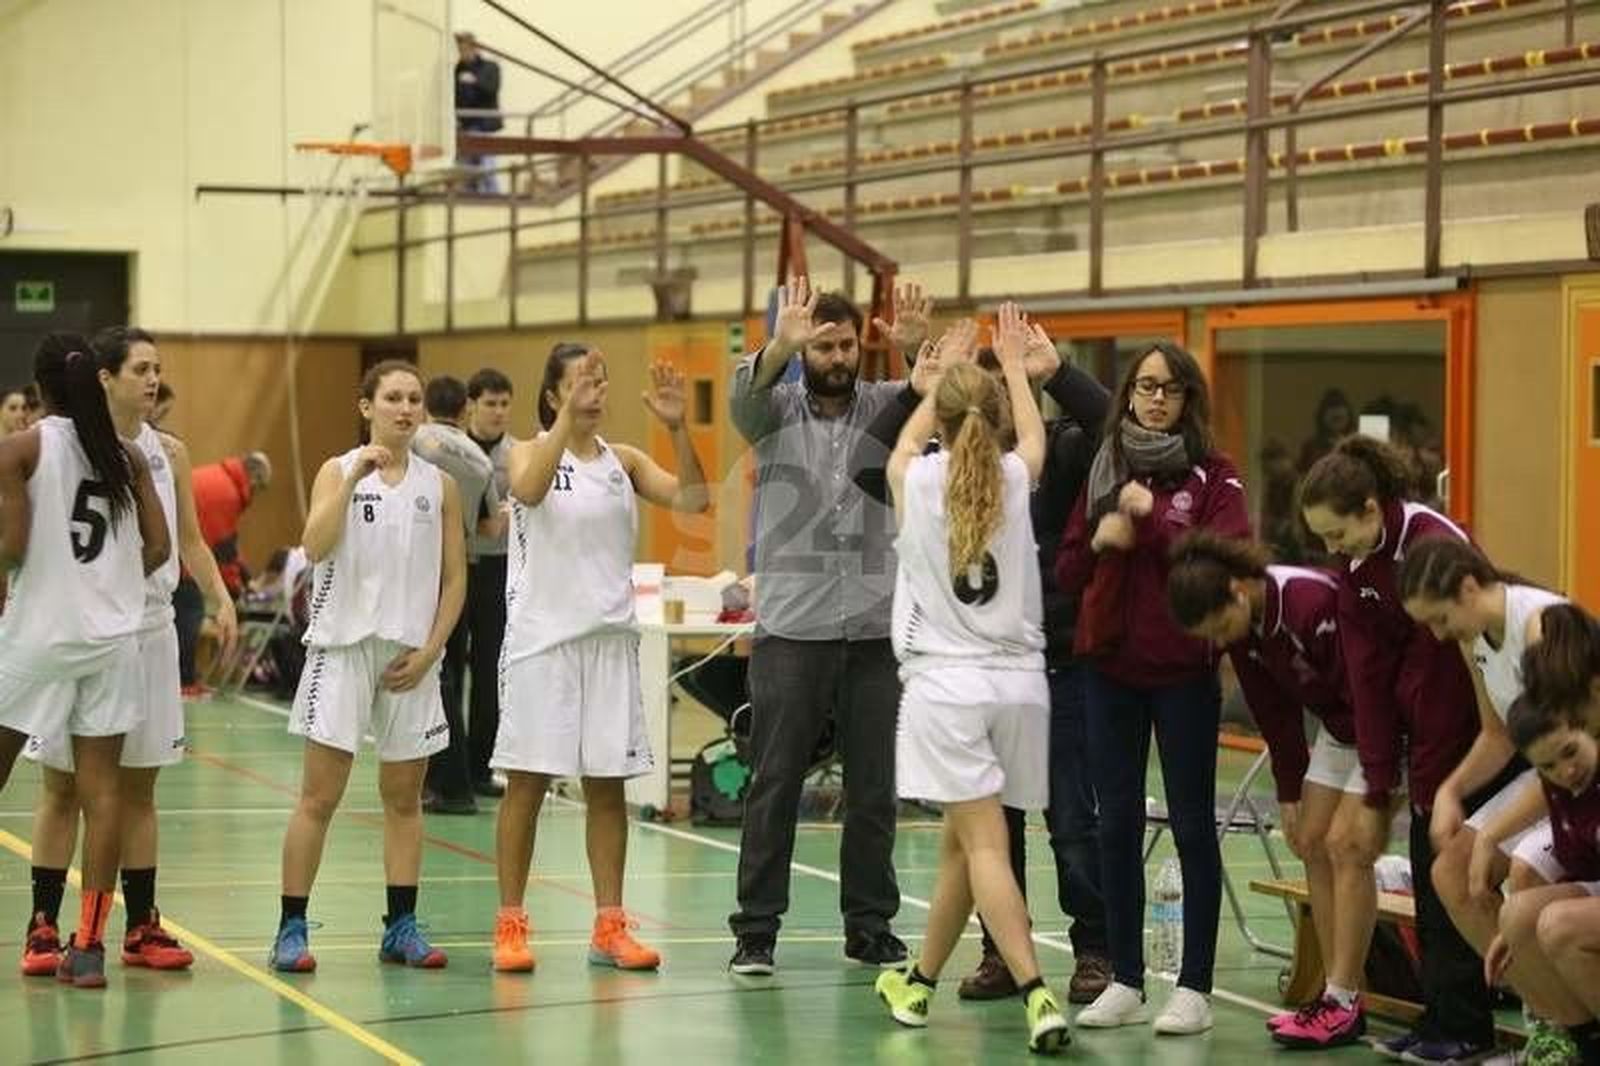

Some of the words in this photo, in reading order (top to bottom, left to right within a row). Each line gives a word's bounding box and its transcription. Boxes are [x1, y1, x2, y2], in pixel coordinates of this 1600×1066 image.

[553, 473, 572, 491] 11
[70, 479, 112, 564] 5
[363, 503, 375, 523] 8
